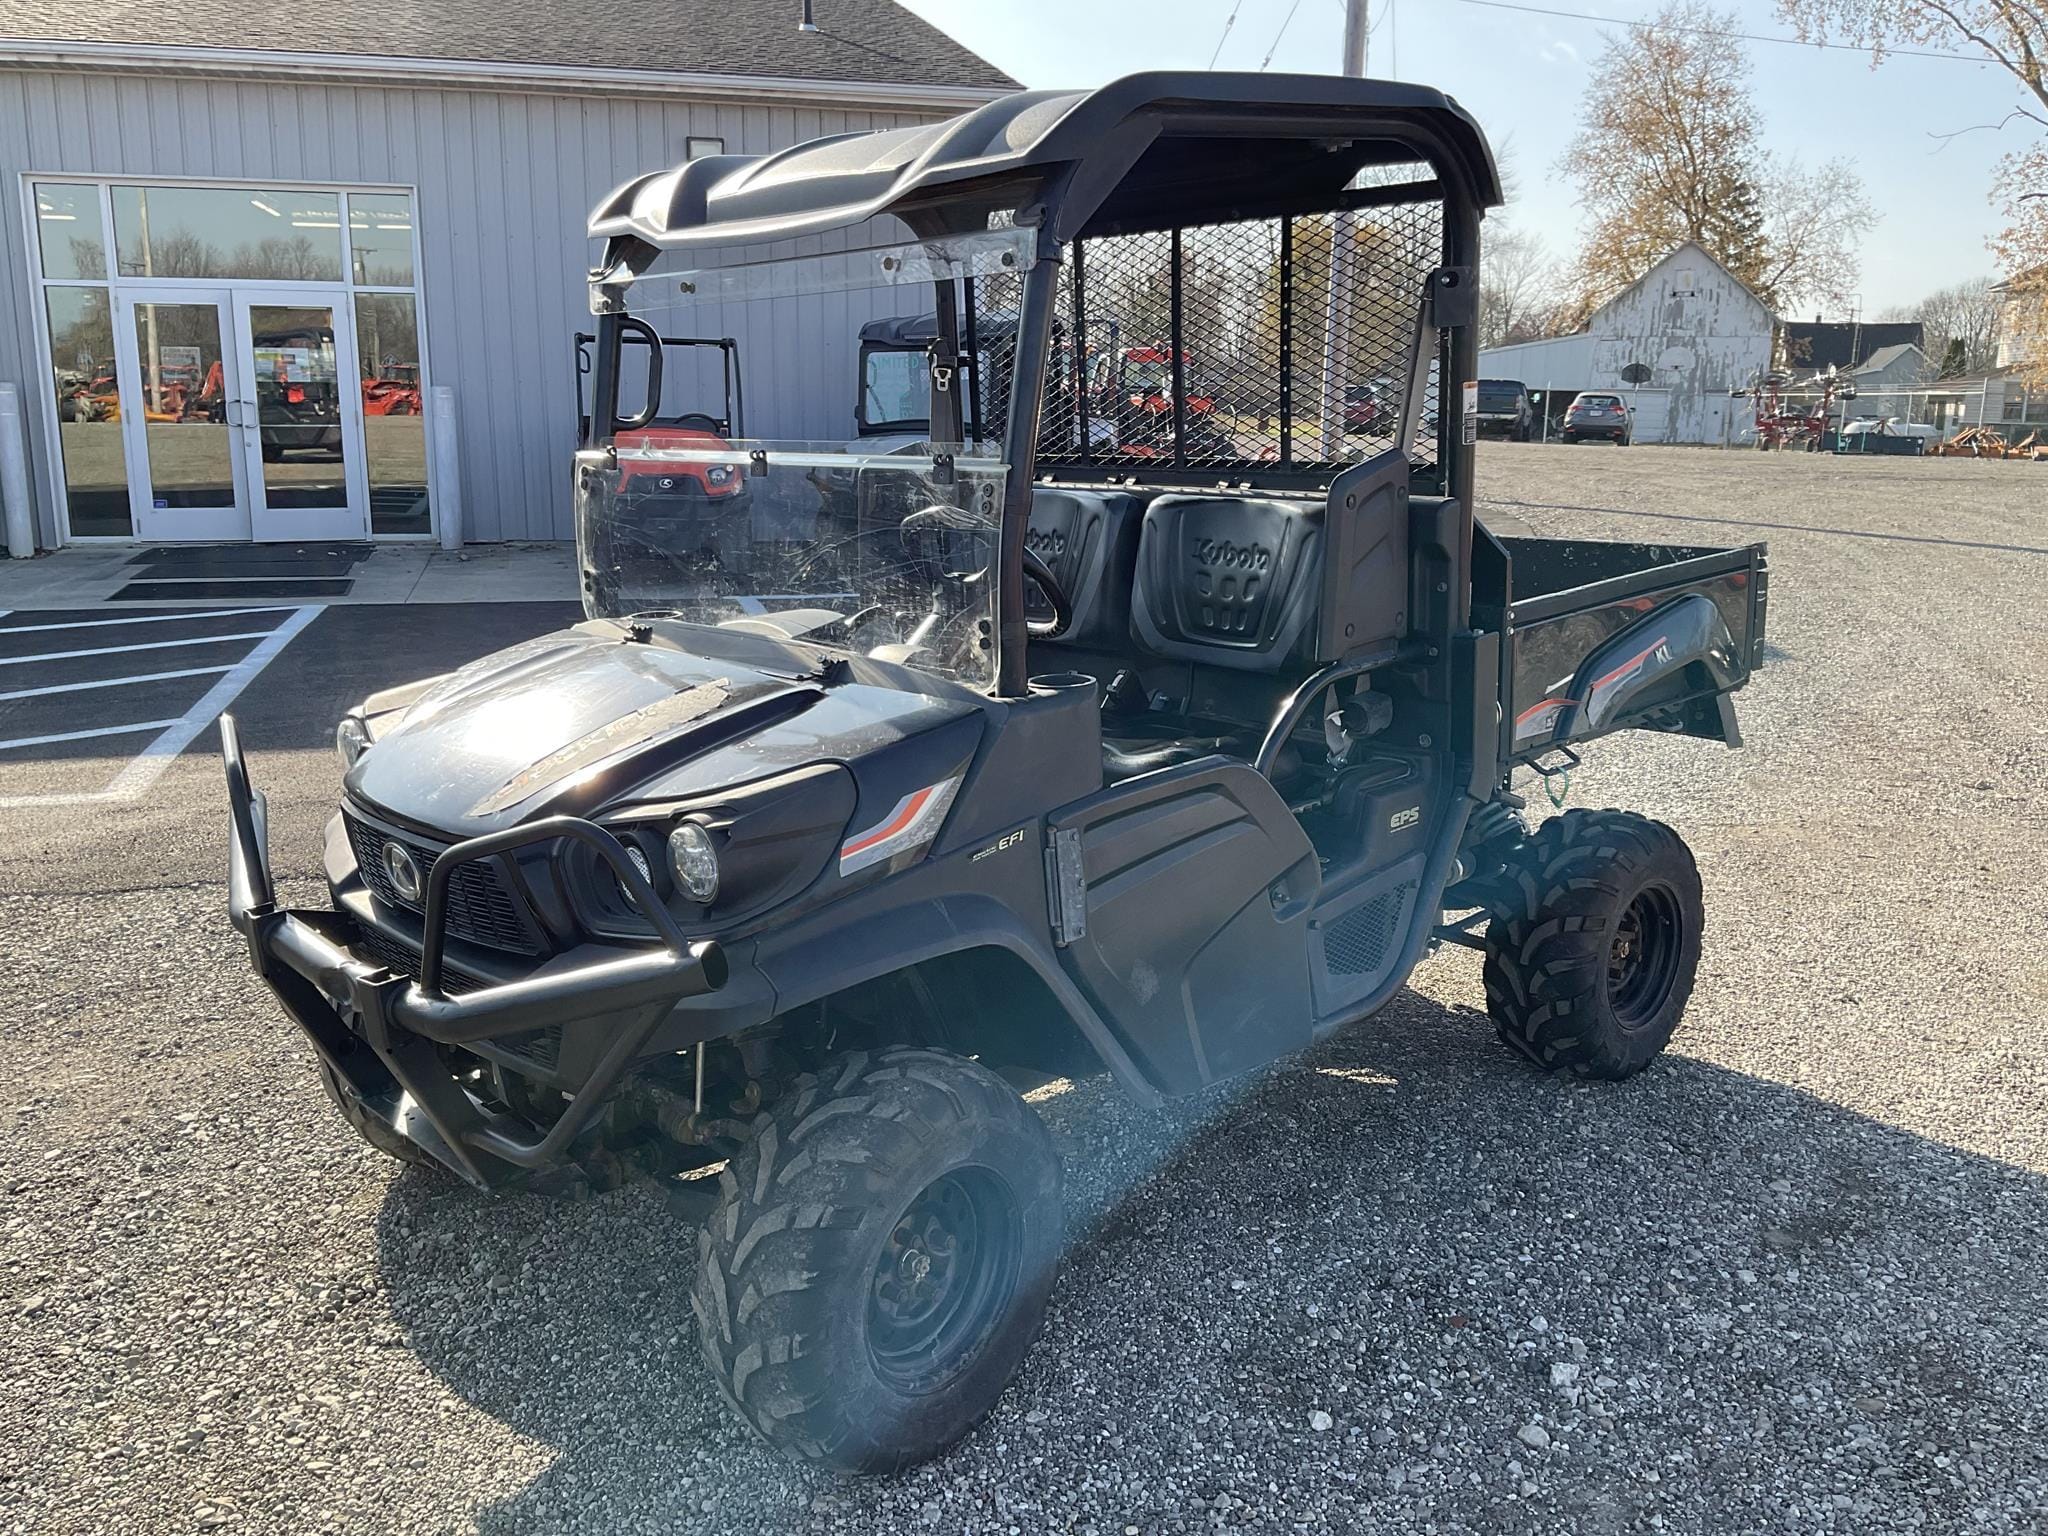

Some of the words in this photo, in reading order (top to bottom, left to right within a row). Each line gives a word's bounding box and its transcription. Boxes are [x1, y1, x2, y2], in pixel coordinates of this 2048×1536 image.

[1191, 537, 1269, 574] Kubota
[1390, 806, 1420, 828] EPS
[998, 829, 1024, 850] EFI
